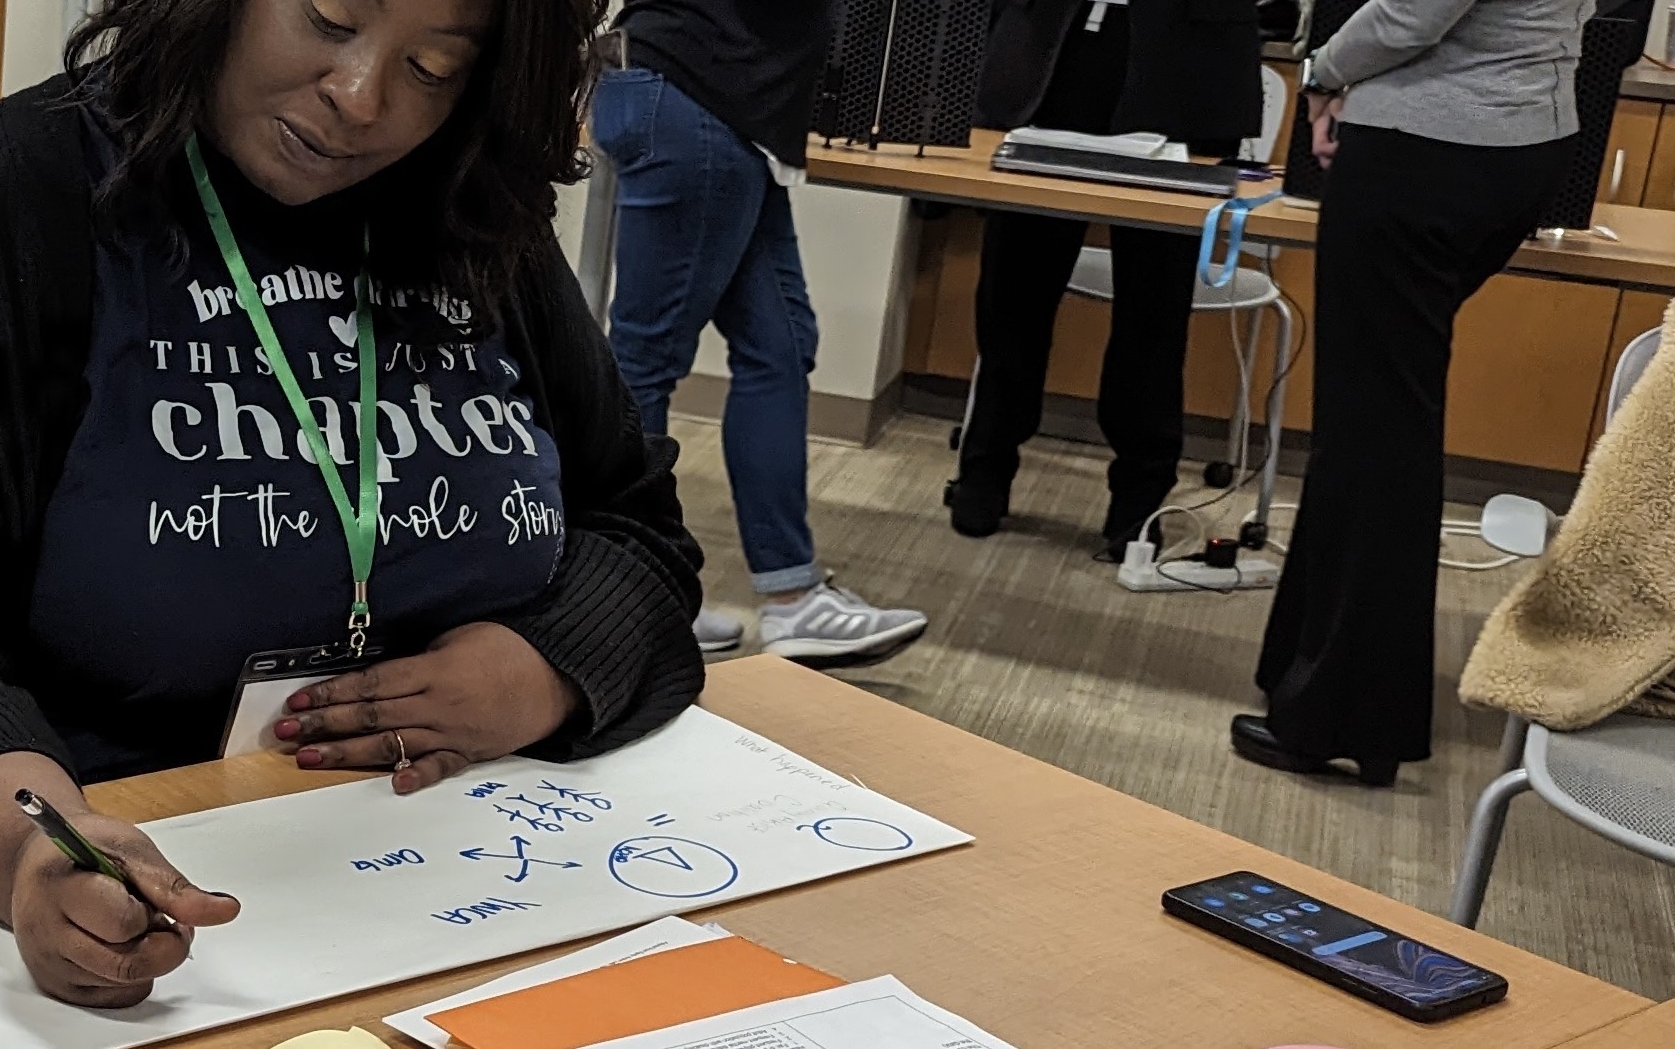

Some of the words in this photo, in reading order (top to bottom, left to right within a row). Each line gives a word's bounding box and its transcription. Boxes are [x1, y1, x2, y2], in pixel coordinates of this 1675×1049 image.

[149, 339, 275, 375] THIS
[307, 351, 359, 380] IS
[151, 382, 539, 483] chapter
[149, 484, 249, 547] not
[246, 483, 318, 547] the
[355, 476, 478, 547] hole
